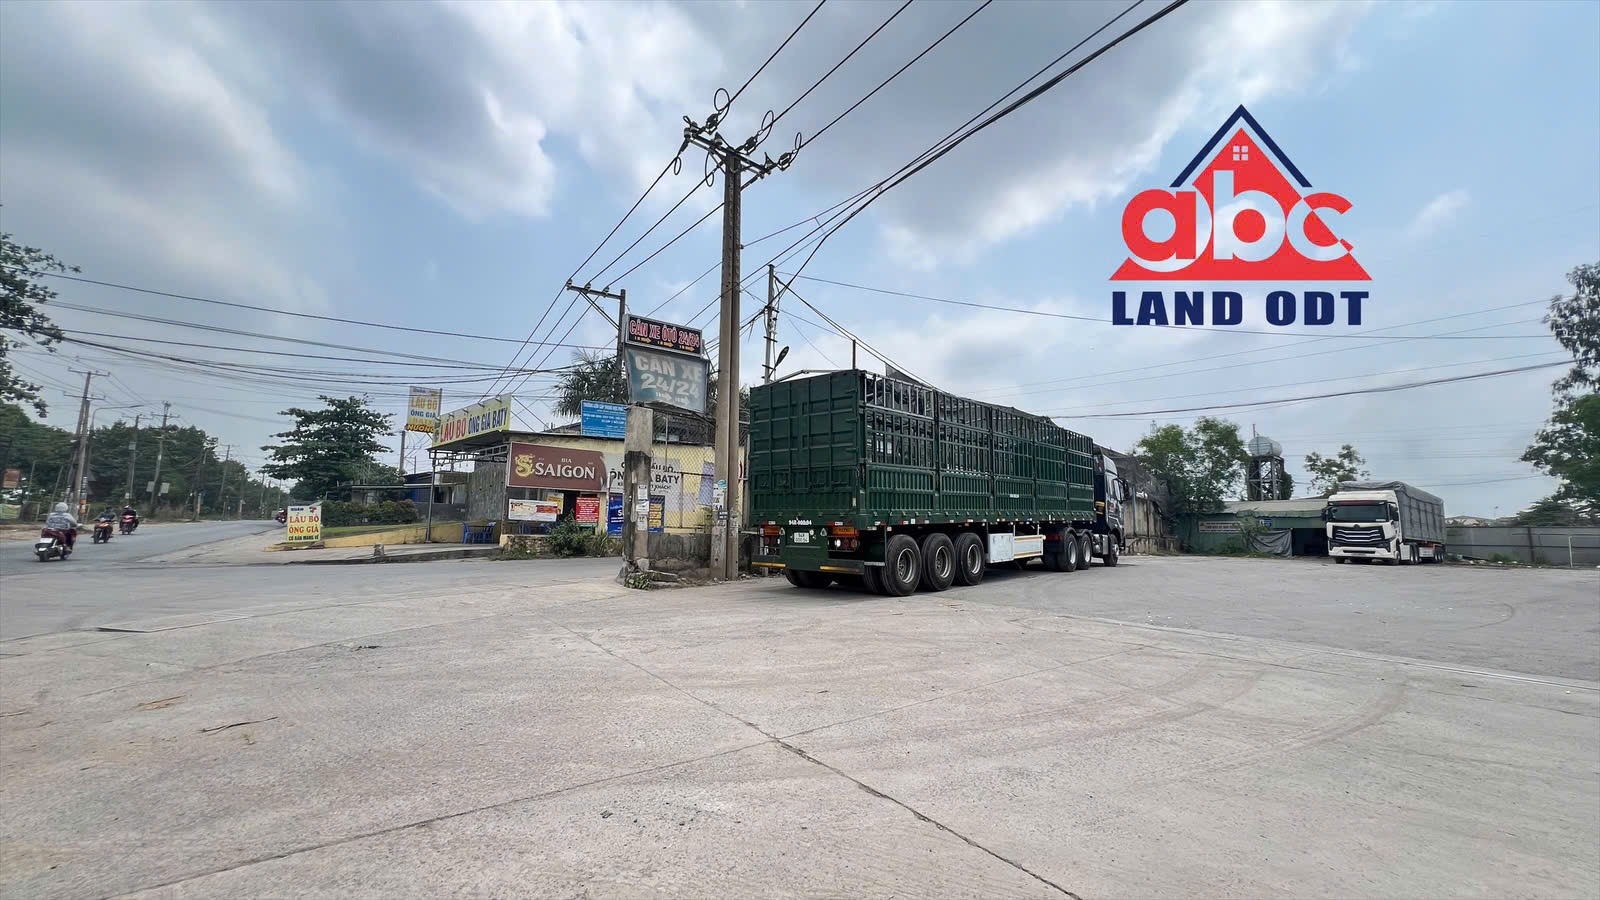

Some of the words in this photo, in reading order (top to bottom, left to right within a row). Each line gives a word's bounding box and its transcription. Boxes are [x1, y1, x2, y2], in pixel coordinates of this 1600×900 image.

[649, 324, 660, 340] XE
[678, 330, 700, 348] 24/24
[640, 373, 699, 399] 24/24
[492, 407, 508, 428] BATY
[535, 462, 595, 480] SAIGON
[655, 474, 680, 484] BATY
[289, 524, 304, 533] ÔNG
